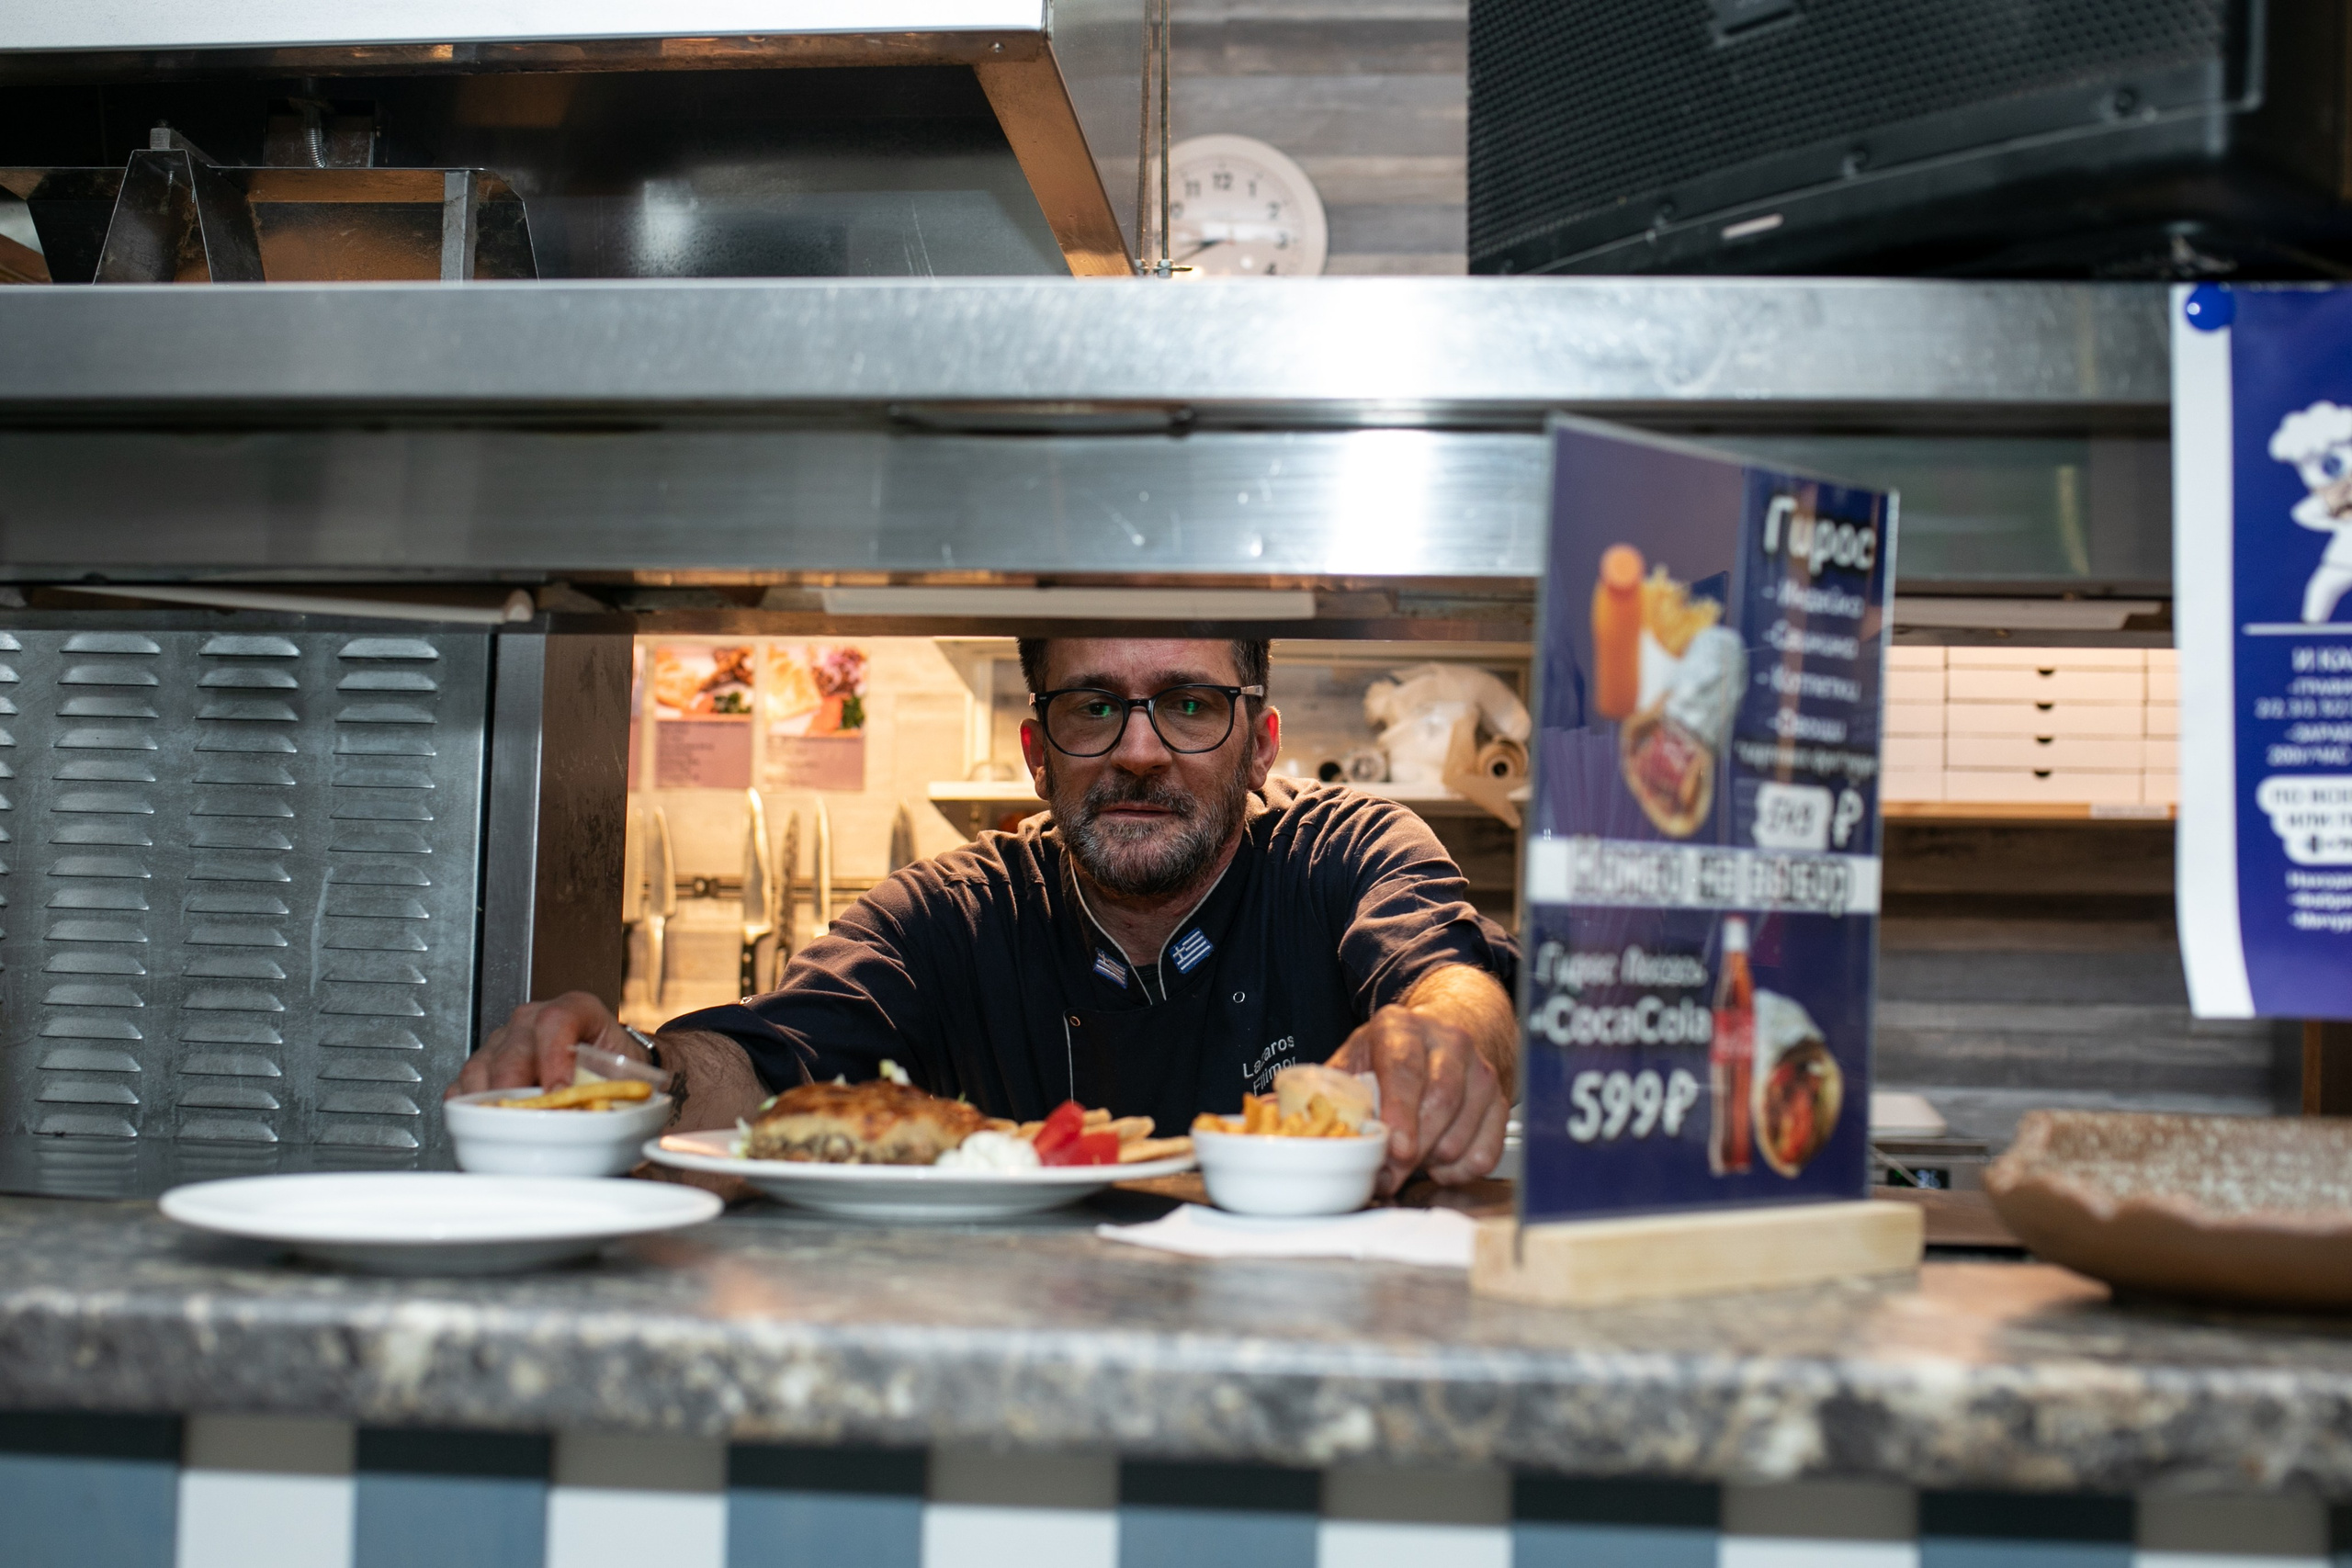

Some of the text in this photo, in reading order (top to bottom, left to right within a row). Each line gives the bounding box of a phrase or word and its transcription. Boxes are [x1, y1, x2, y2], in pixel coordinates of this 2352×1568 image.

[1212, 172, 1233, 191] 12
[1763, 494, 1876, 576] Гирос
[2316, 646, 2352, 672] КА
[1242, 1035, 1295, 1079] Lazaros
